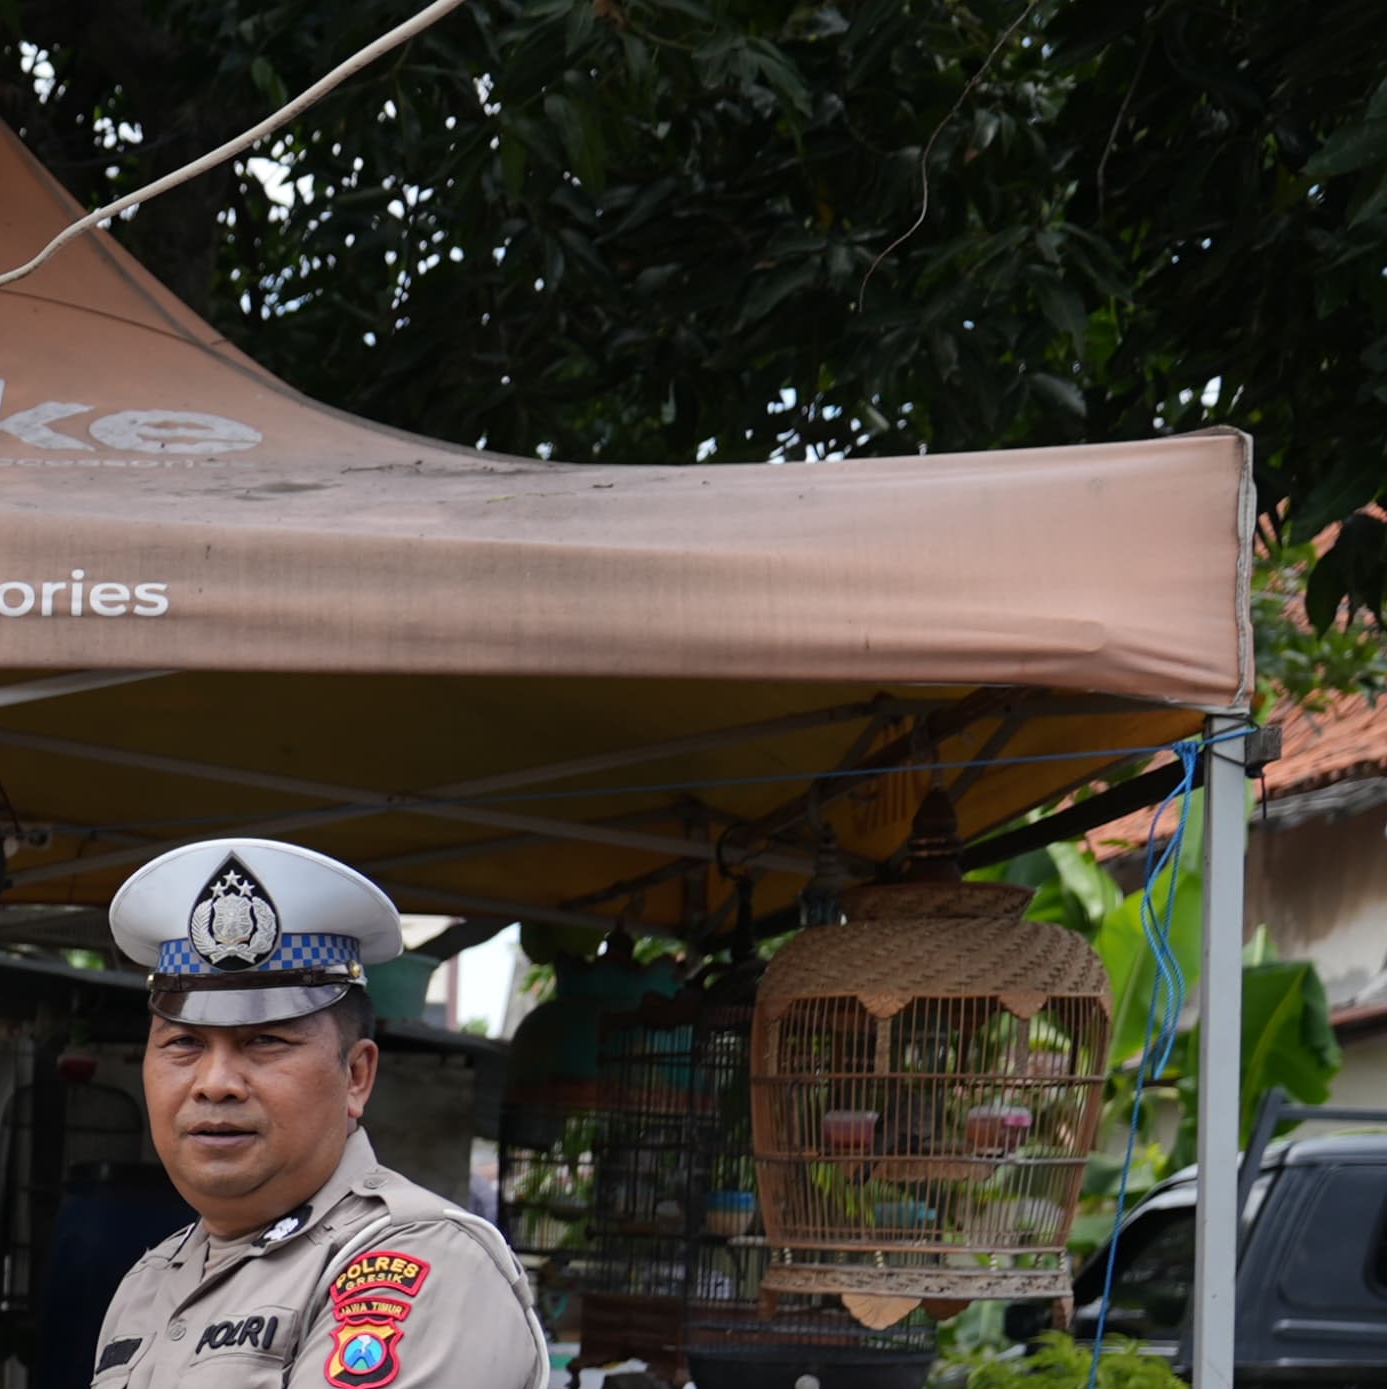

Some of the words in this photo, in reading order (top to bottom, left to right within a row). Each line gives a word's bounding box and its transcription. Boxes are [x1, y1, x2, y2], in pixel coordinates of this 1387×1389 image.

[336, 1256, 420, 1288] POLRES
[345, 1272, 405, 1290] GRESIK
[340, 1303, 368, 1316] JAWA
[371, 1302, 403, 1315] TIMUR
